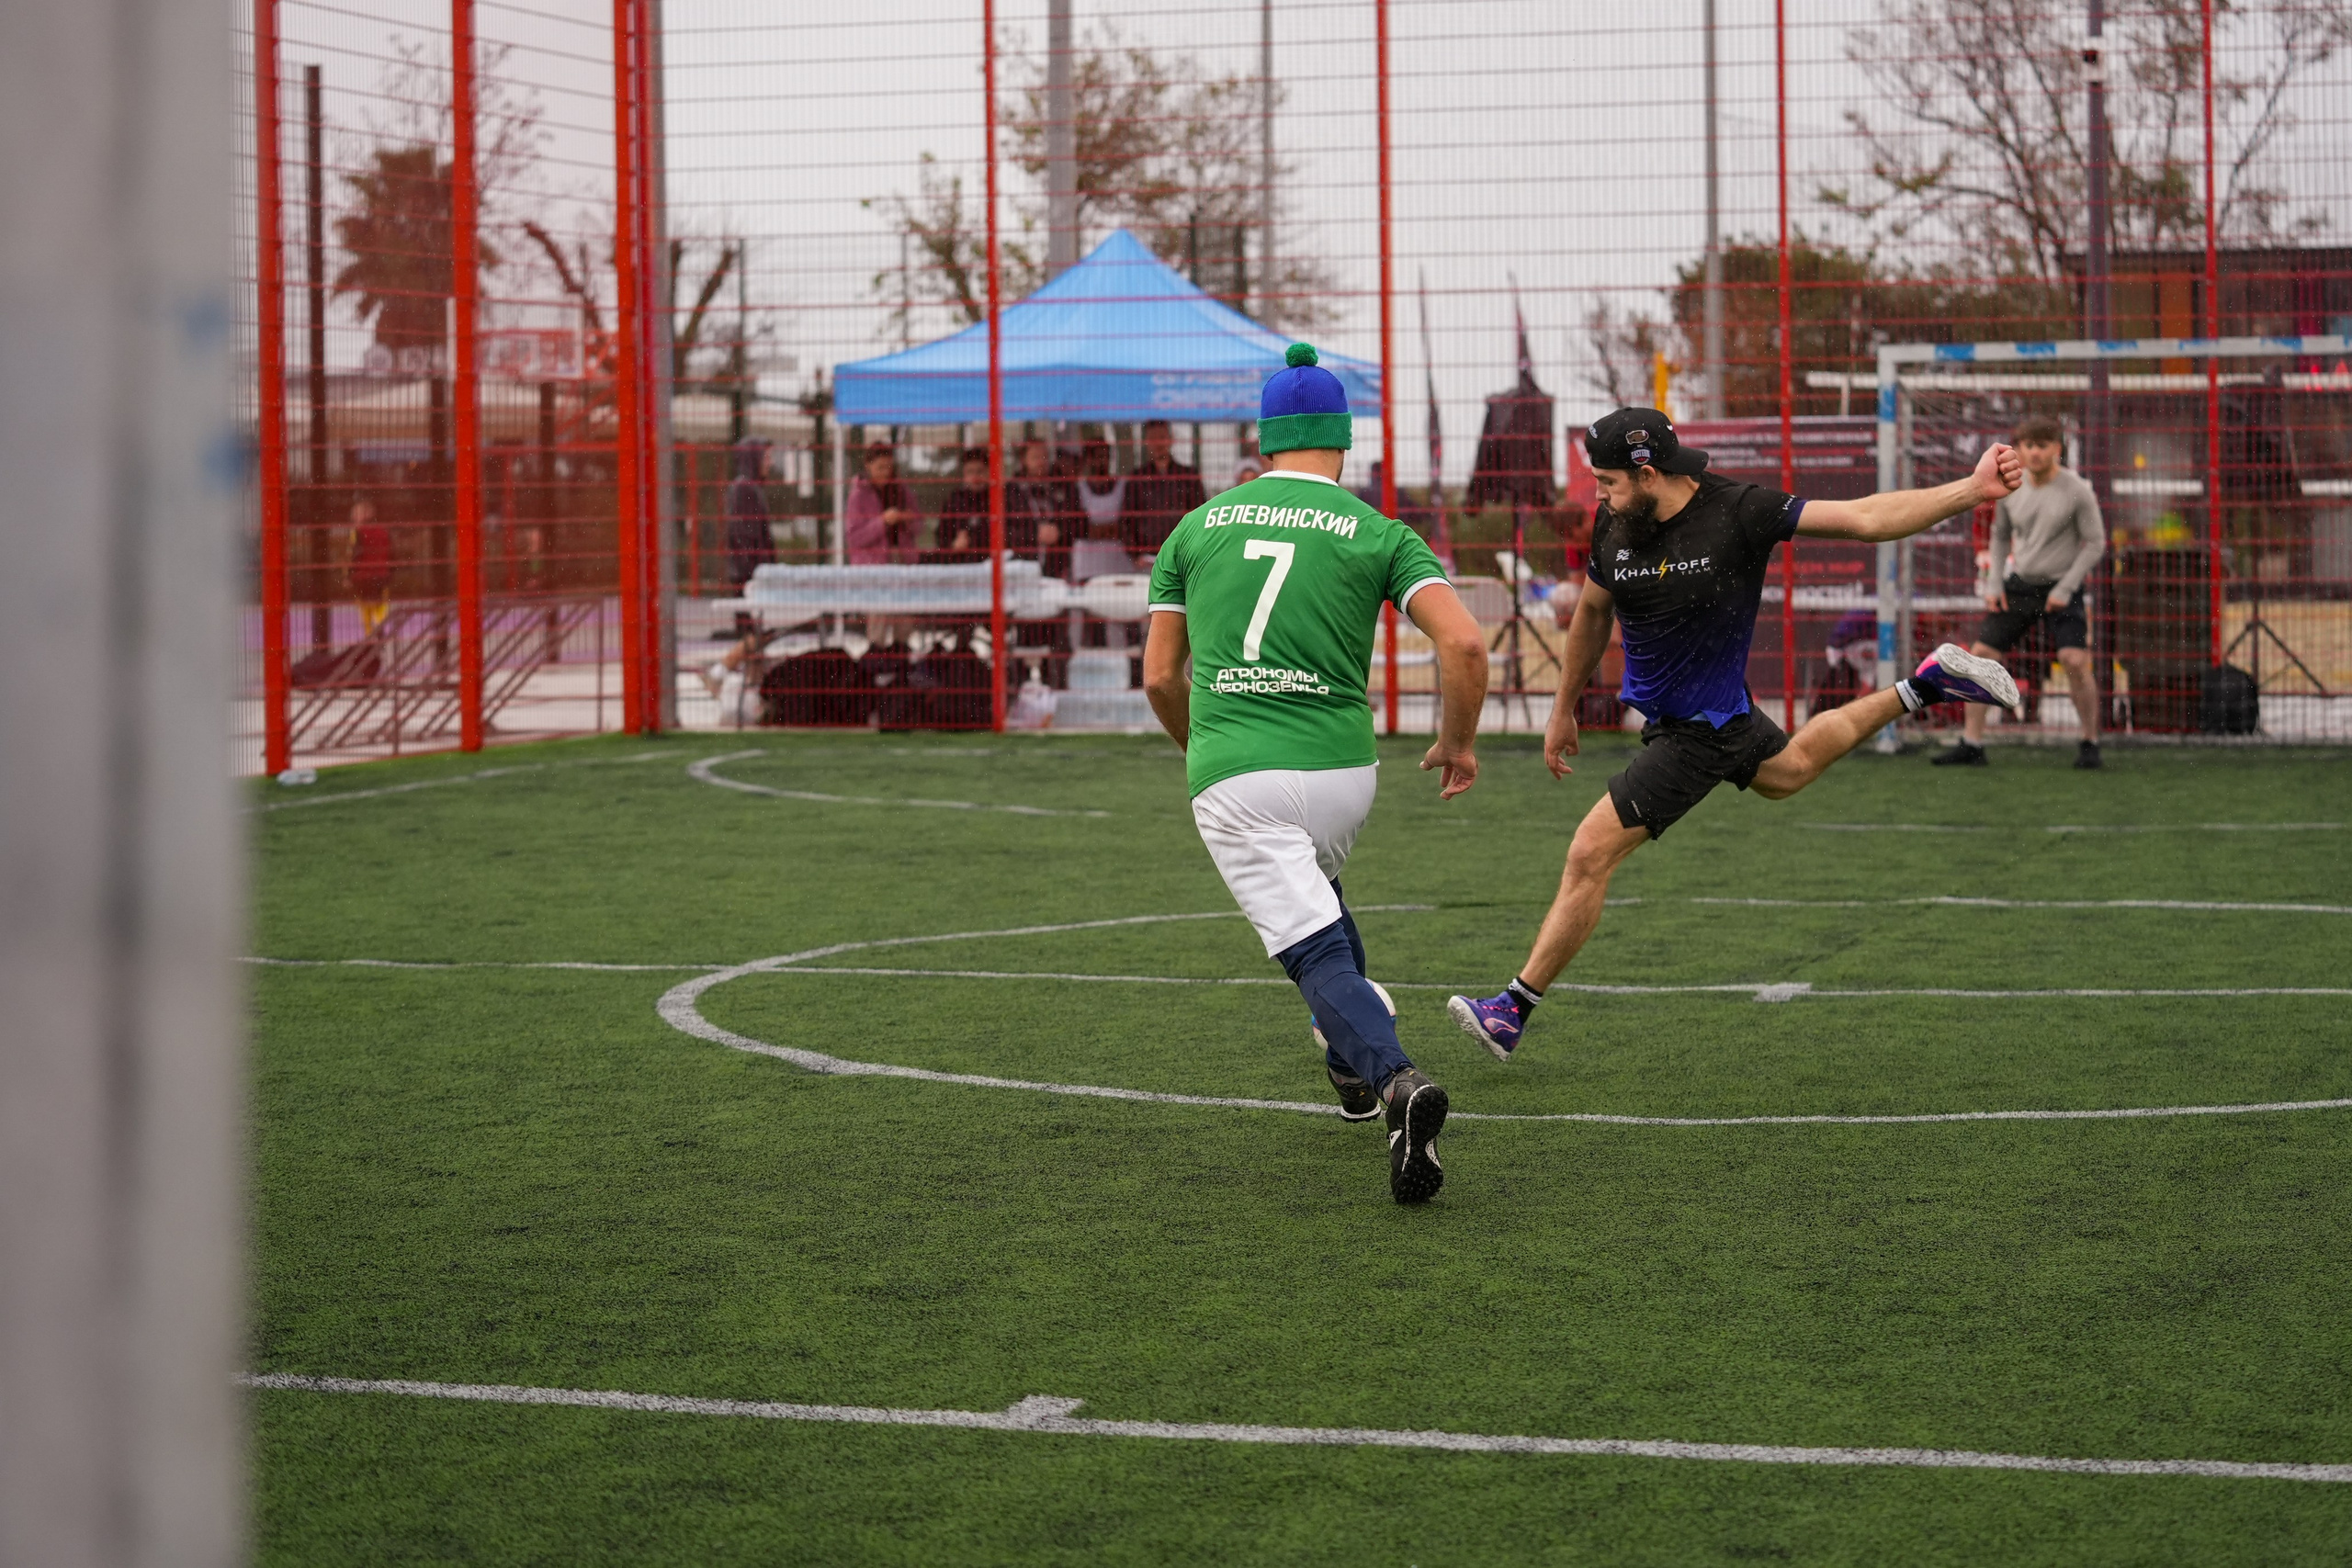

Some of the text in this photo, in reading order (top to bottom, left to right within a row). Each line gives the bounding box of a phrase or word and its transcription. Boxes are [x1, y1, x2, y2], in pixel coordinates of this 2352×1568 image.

[1204, 504, 1359, 540] БЕЛЕВИНСКИЙ
[1681, 566, 1711, 576] TEAM
[1243, 538, 1295, 661] 7
[1216, 667, 1319, 683] АГРОНОМЫ
